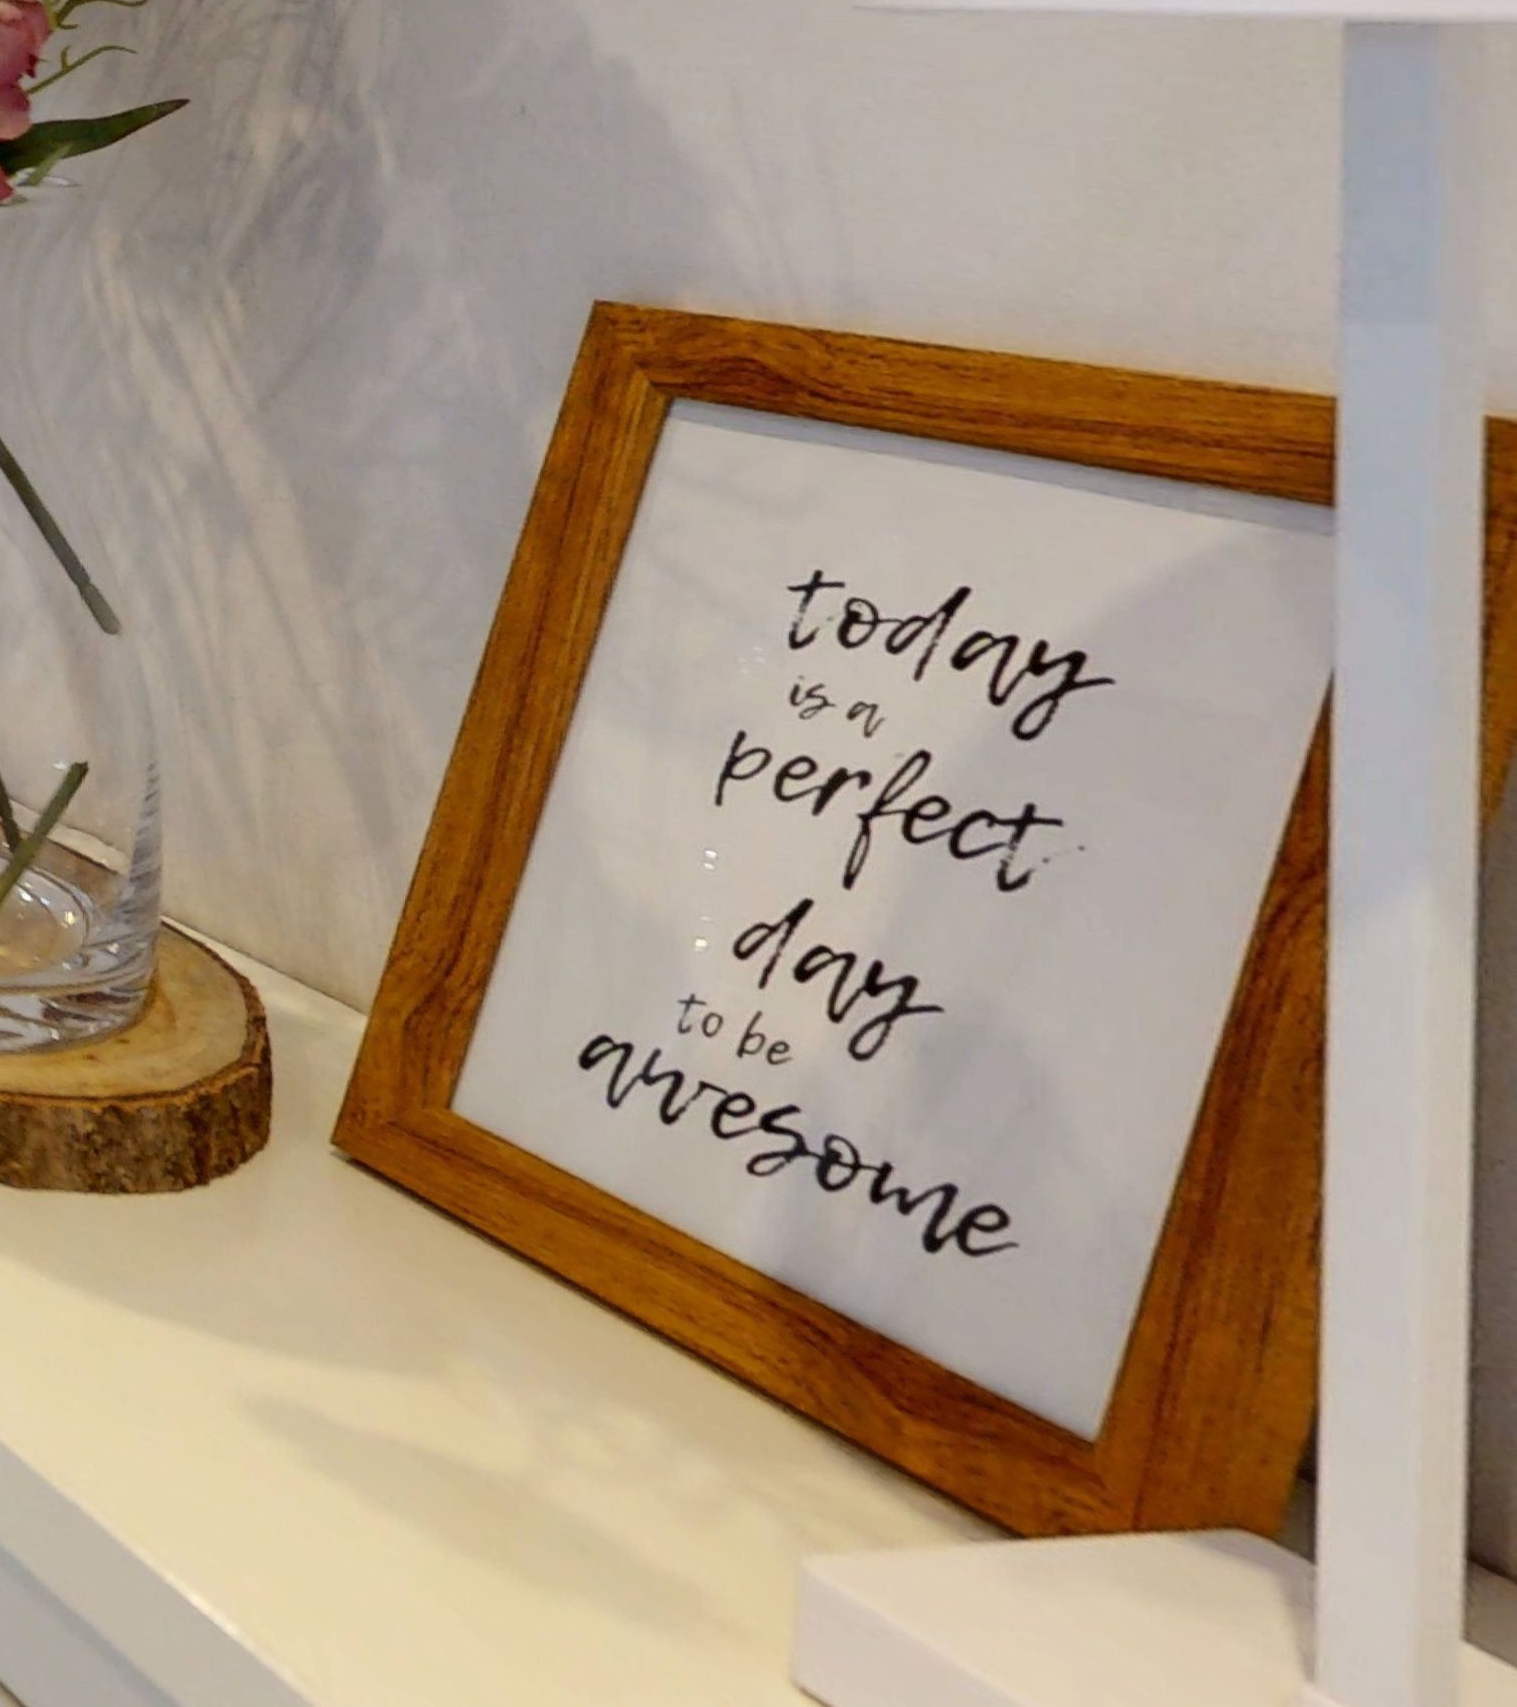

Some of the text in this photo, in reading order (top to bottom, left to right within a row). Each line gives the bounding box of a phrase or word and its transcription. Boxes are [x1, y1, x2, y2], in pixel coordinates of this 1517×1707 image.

[787, 569, 1116, 742] today
[788, 676, 886, 739] is a
[714, 729, 1065, 893] perfect
[677, 993, 794, 1066] to be
[732, 897, 945, 1063] day
[577, 1033, 1019, 1258] awesome
